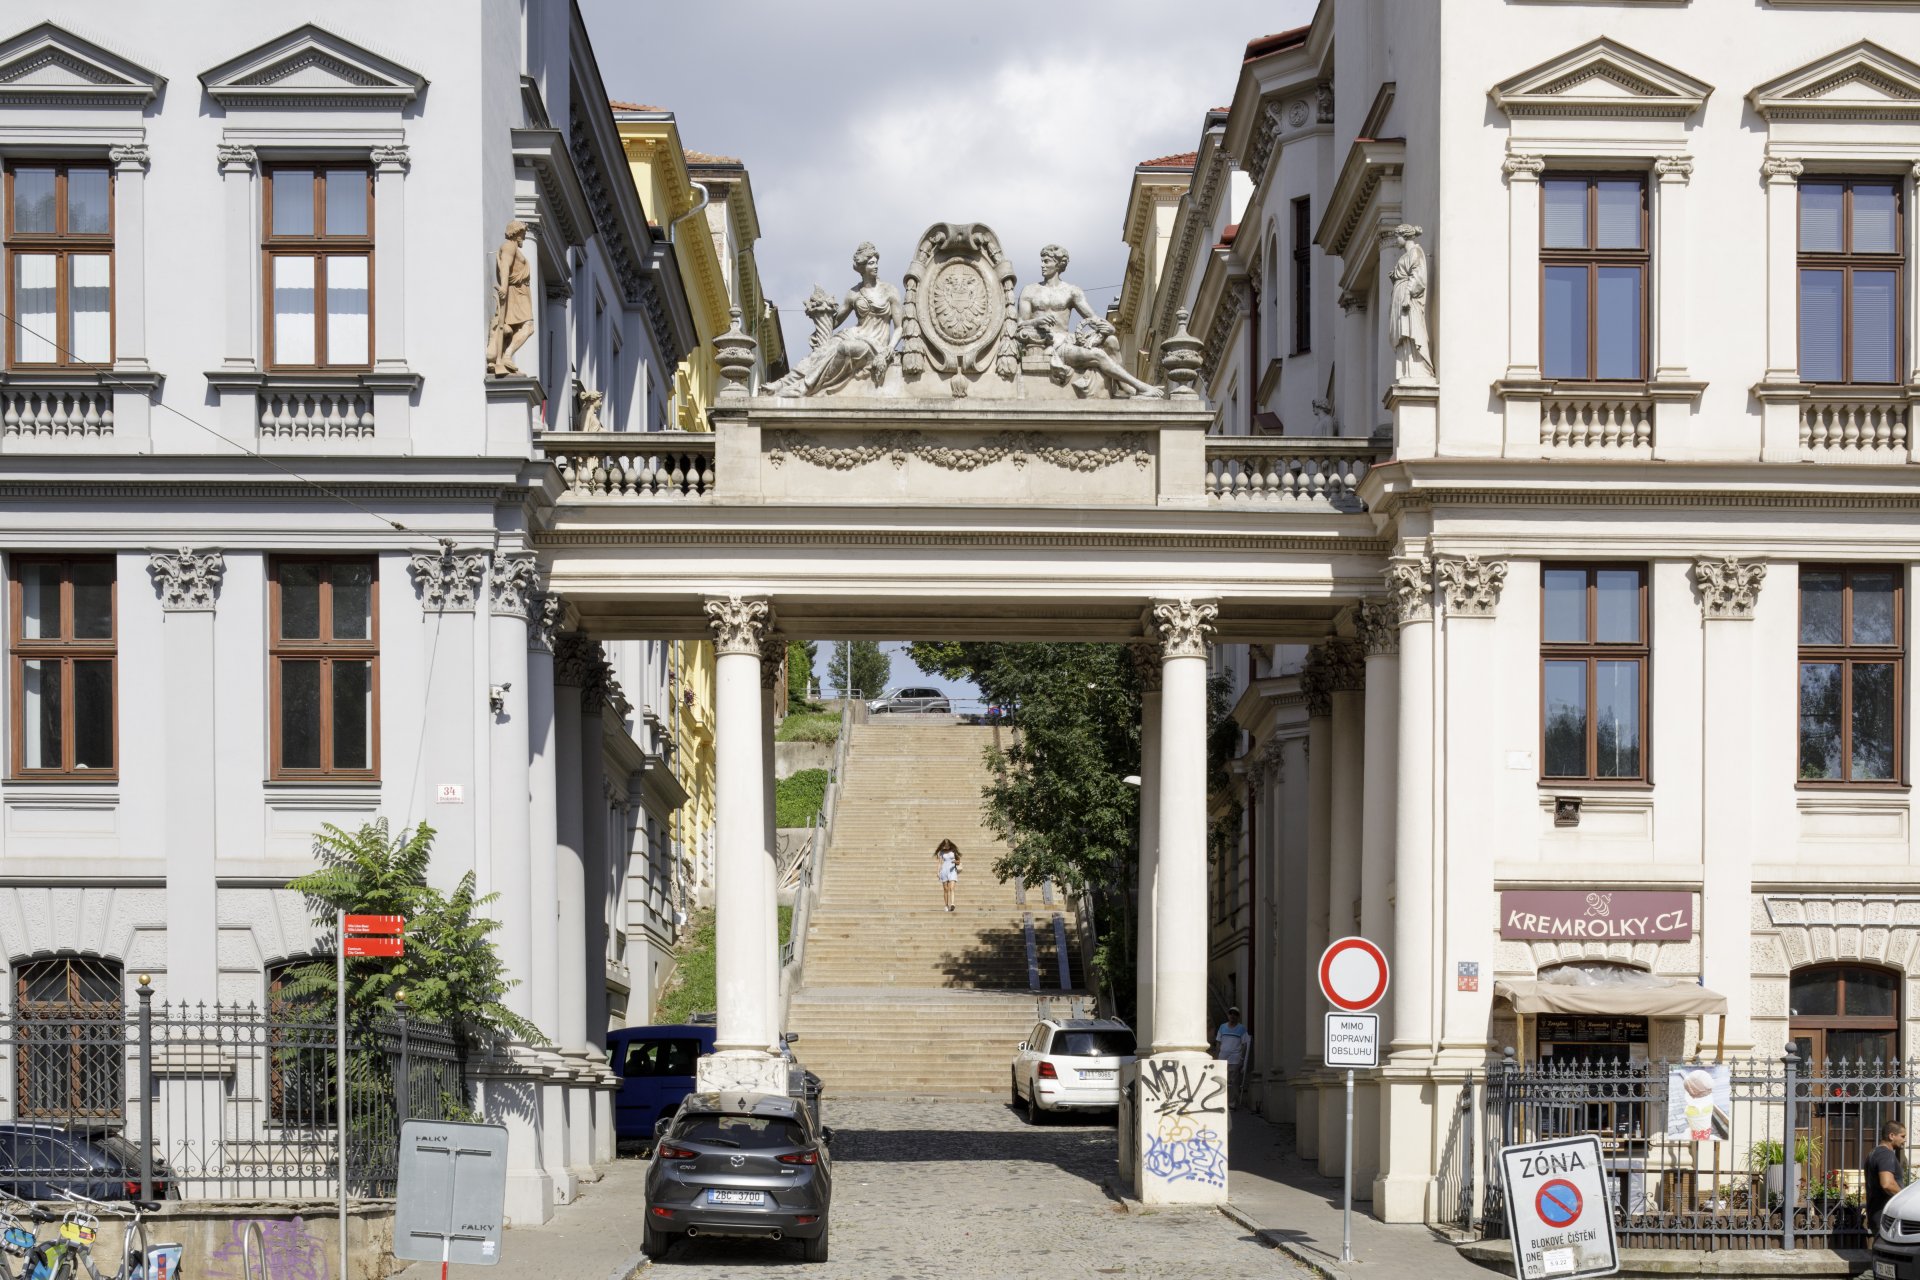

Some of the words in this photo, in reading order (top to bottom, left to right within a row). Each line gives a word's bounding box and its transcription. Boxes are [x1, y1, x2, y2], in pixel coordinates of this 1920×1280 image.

[443, 786, 456, 795] 34
[1507, 909, 1688, 937] KREMROLKY.CZ
[1340, 1022, 1364, 1031] MIMO
[1330, 1034, 1374, 1044] DOPRAVNÍ
[1331, 1046, 1372, 1056] OBSLUHU
[1519, 1151, 1586, 1178] ZÓNA
[716, 1190, 732, 1200] 2BC
[738, 1192, 760, 1201] 3700
[1531, 1232, 1564, 1249] BLOKOVÉ
[1567, 1228, 1597, 1244] ČIŠTĚNÍ
